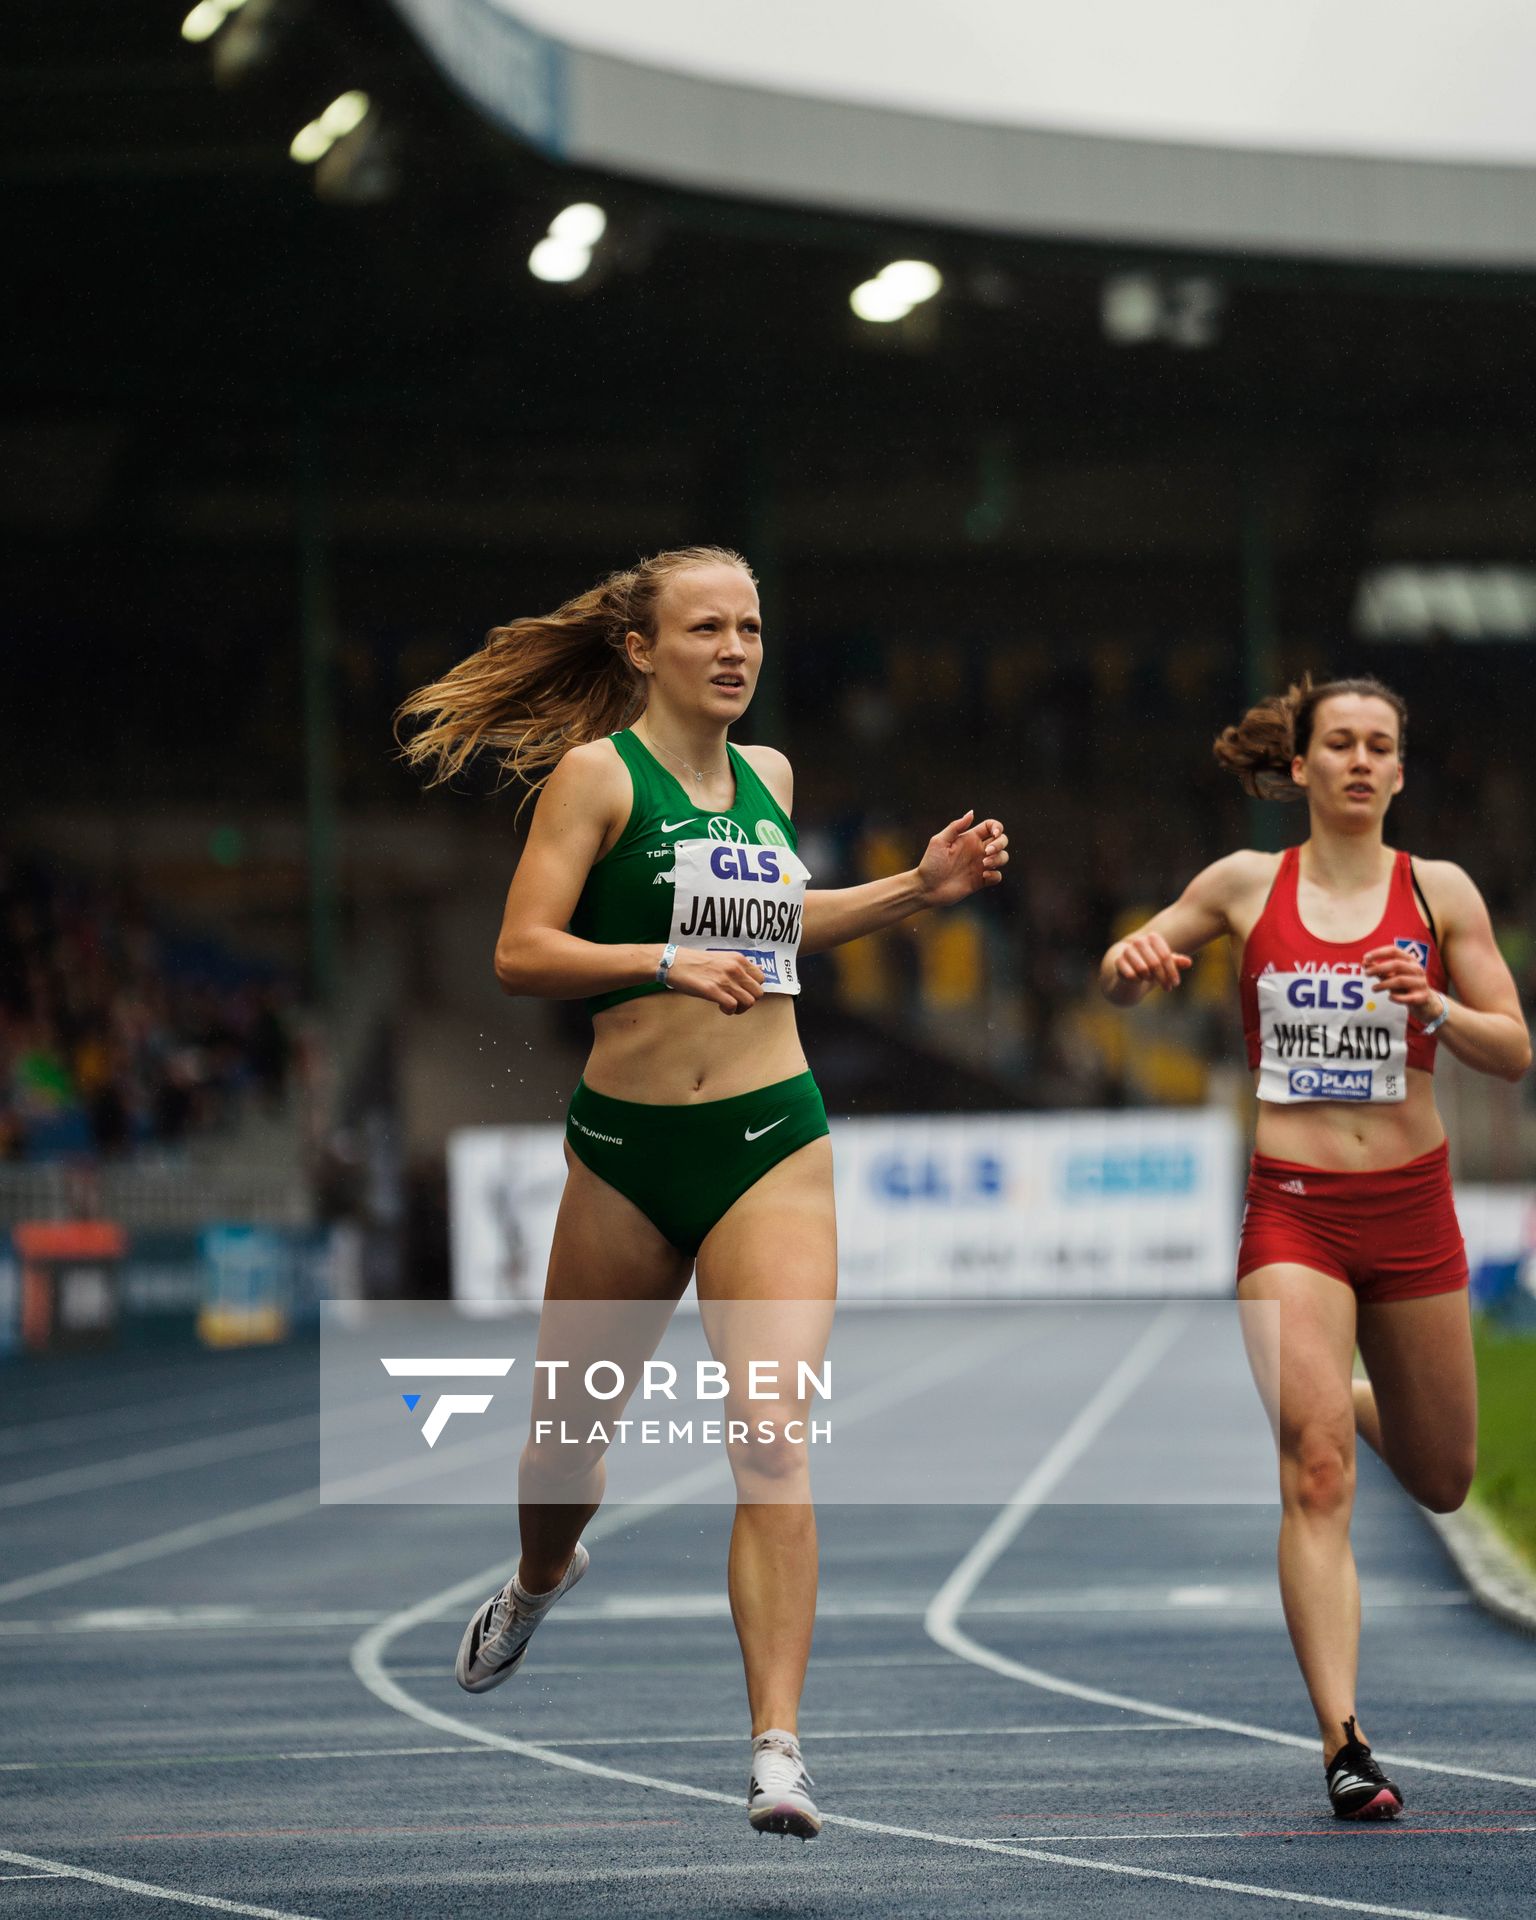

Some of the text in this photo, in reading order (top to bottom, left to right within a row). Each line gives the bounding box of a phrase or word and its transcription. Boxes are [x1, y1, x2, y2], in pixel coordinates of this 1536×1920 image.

[680, 895, 802, 945] JAWORSKI
[784, 959, 794, 982] 656
[1274, 1024, 1391, 1061] WIELAND
[1321, 1073, 1369, 1090] PLAN
[1385, 1075, 1397, 1097] 553
